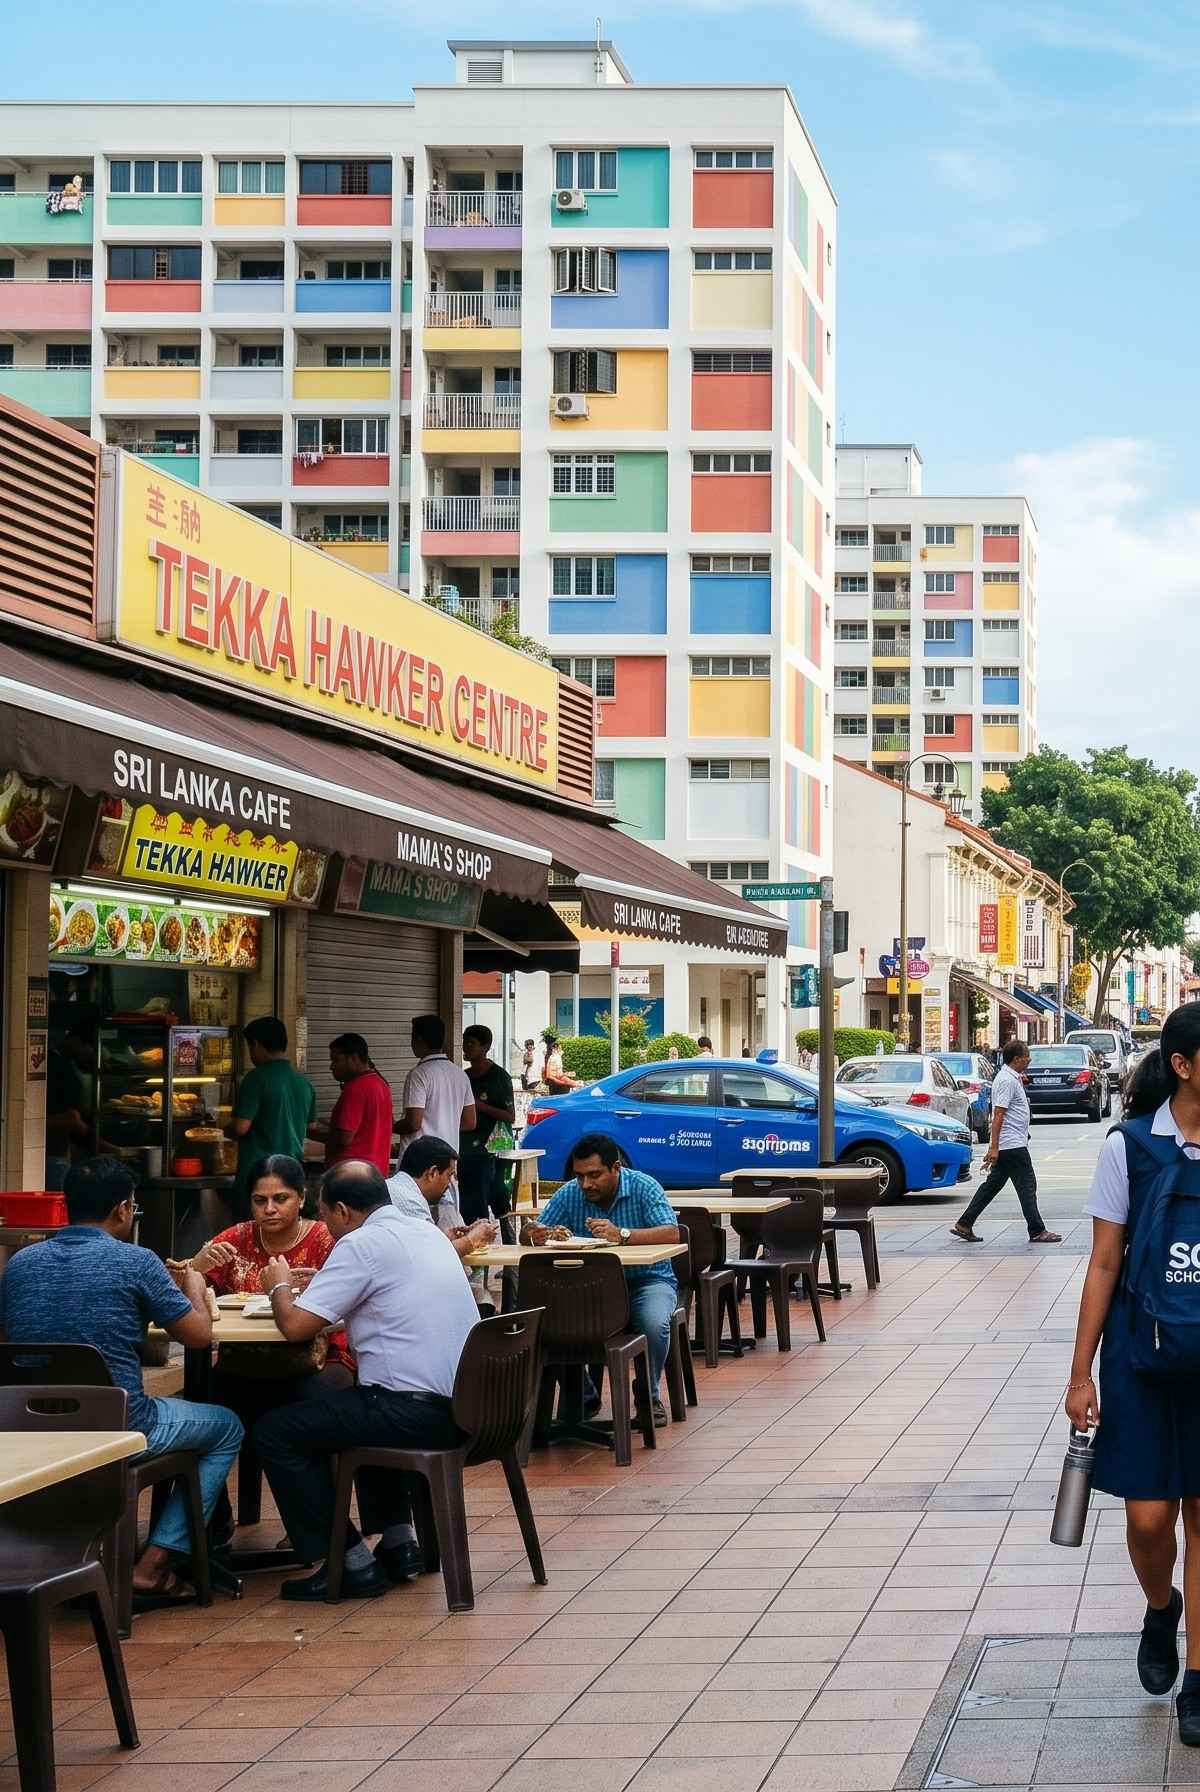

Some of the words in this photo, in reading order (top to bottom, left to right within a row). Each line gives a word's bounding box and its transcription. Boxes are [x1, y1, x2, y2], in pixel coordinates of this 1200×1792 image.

[149, 538, 297, 680] TEKKA
[304, 609, 444, 735] HAWKER
[450, 674, 548, 772] CENTRE
[113, 749, 151, 794] SRI
[160, 762, 235, 816] LANKA
[239, 786, 291, 830] CAFE
[136, 838, 203, 879] TEKKA
[207, 852, 288, 892] HAWKER
[397, 831, 452, 872] MAMA'S
[456, 848, 492, 881] SHOP
[614, 902, 628, 926] SRI
[631, 905, 657, 930] LANKA
[659, 912, 681, 935] CAFE
